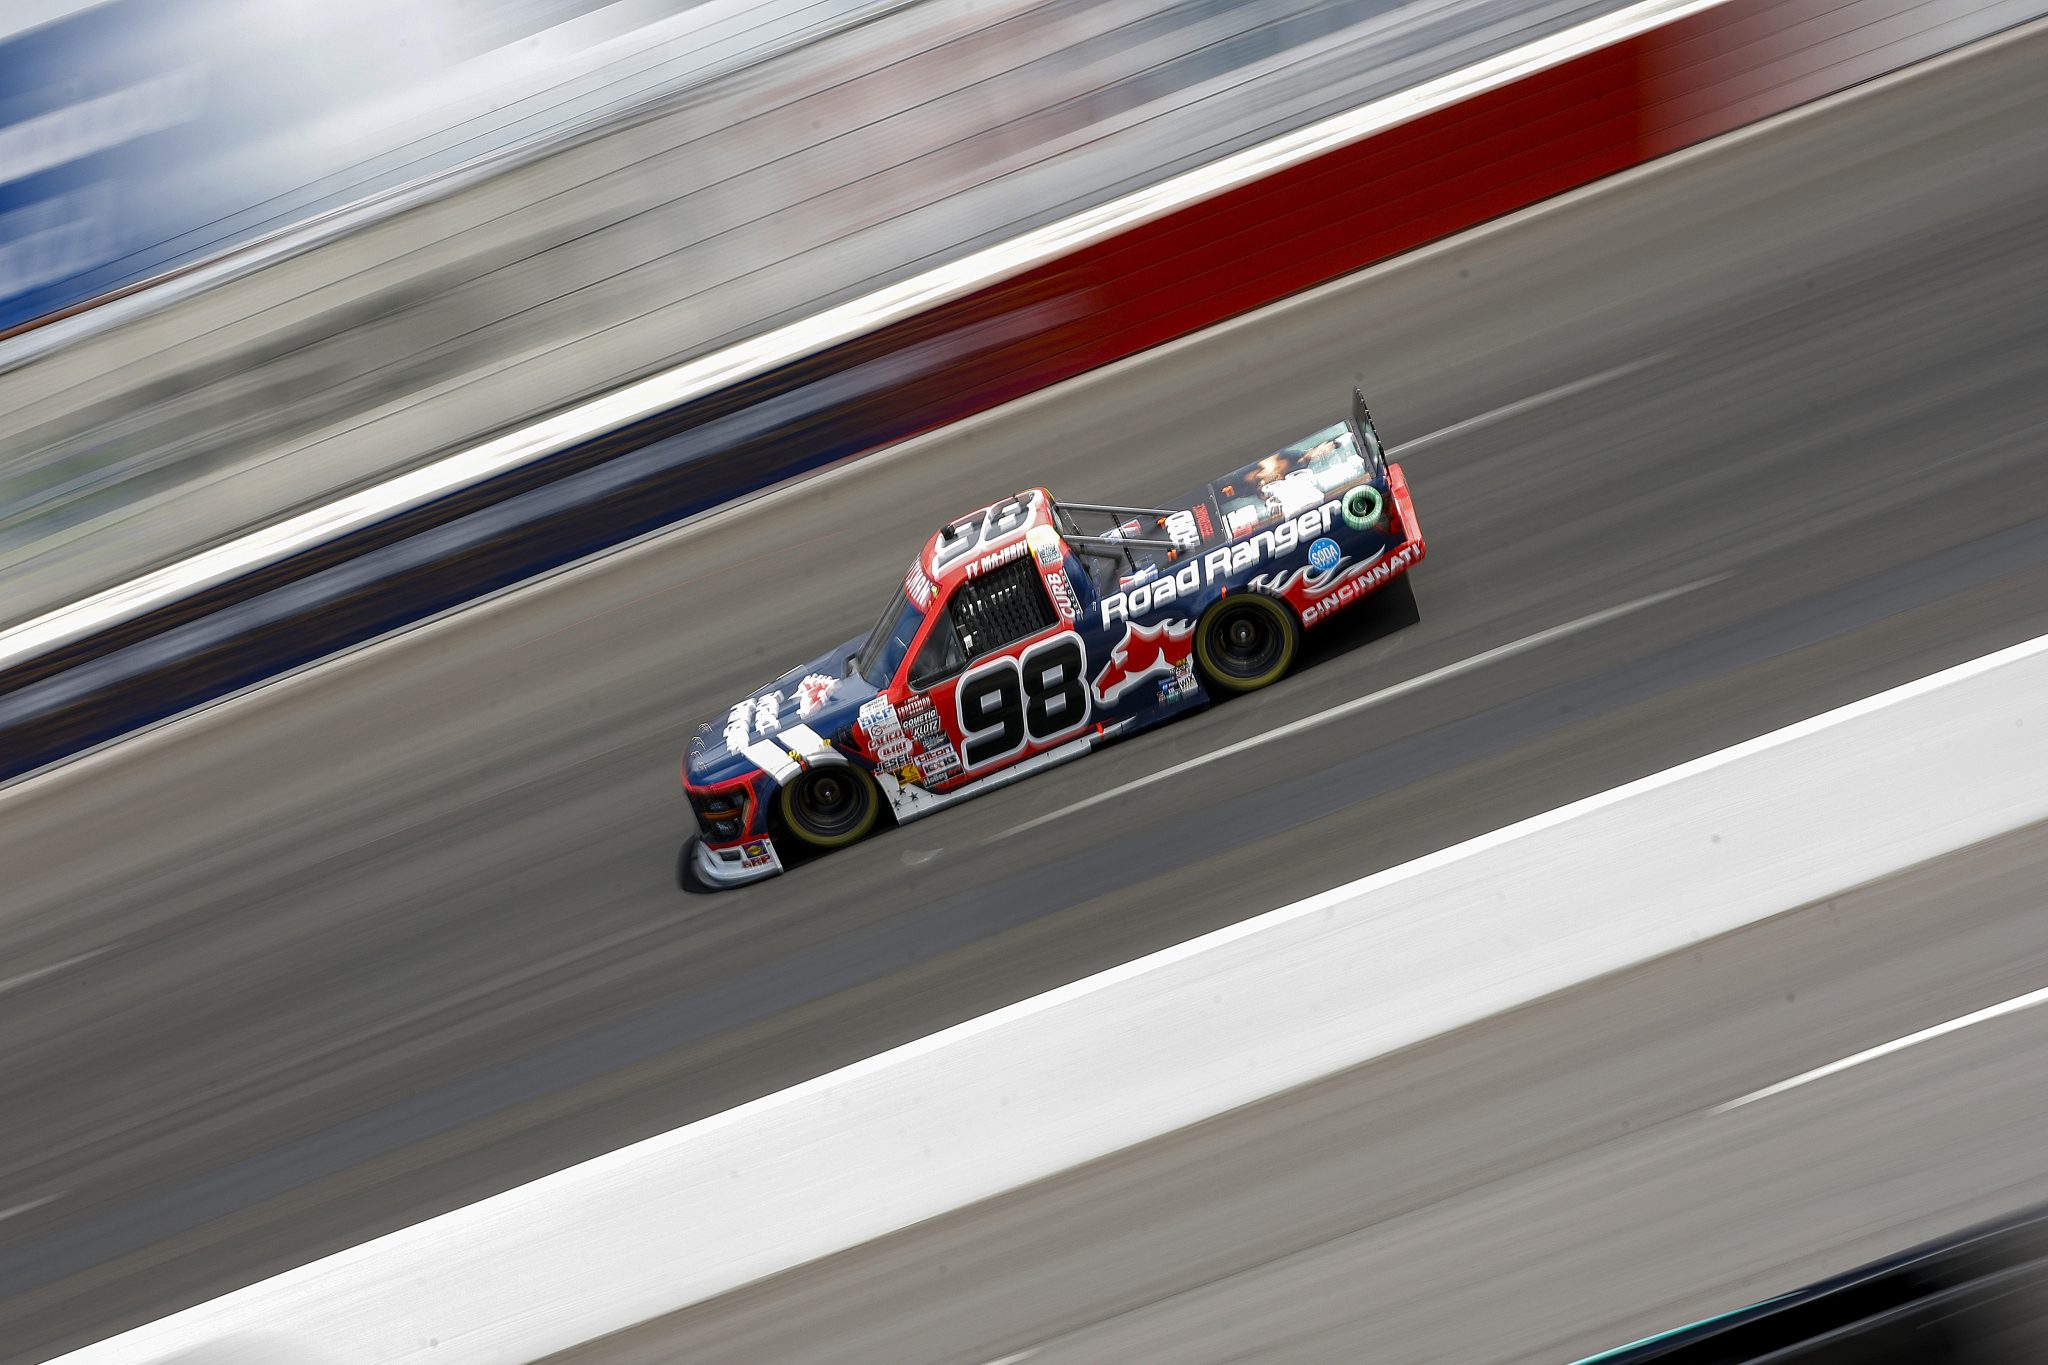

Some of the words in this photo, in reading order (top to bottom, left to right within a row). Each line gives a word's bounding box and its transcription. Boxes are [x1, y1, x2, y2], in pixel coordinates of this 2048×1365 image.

[965, 561, 979, 579] TY
[1101, 559, 1200, 630] Road
[1204, 499, 1342, 586] Ranger
[1312, 544, 1338, 564] SODA
[1047, 573, 1075, 617] CURB
[1302, 543, 1421, 621] CINCINNATI
[861, 706, 892, 727] SKF
[957, 632, 1091, 770] 98
[913, 722, 938, 736] KLOTZ
